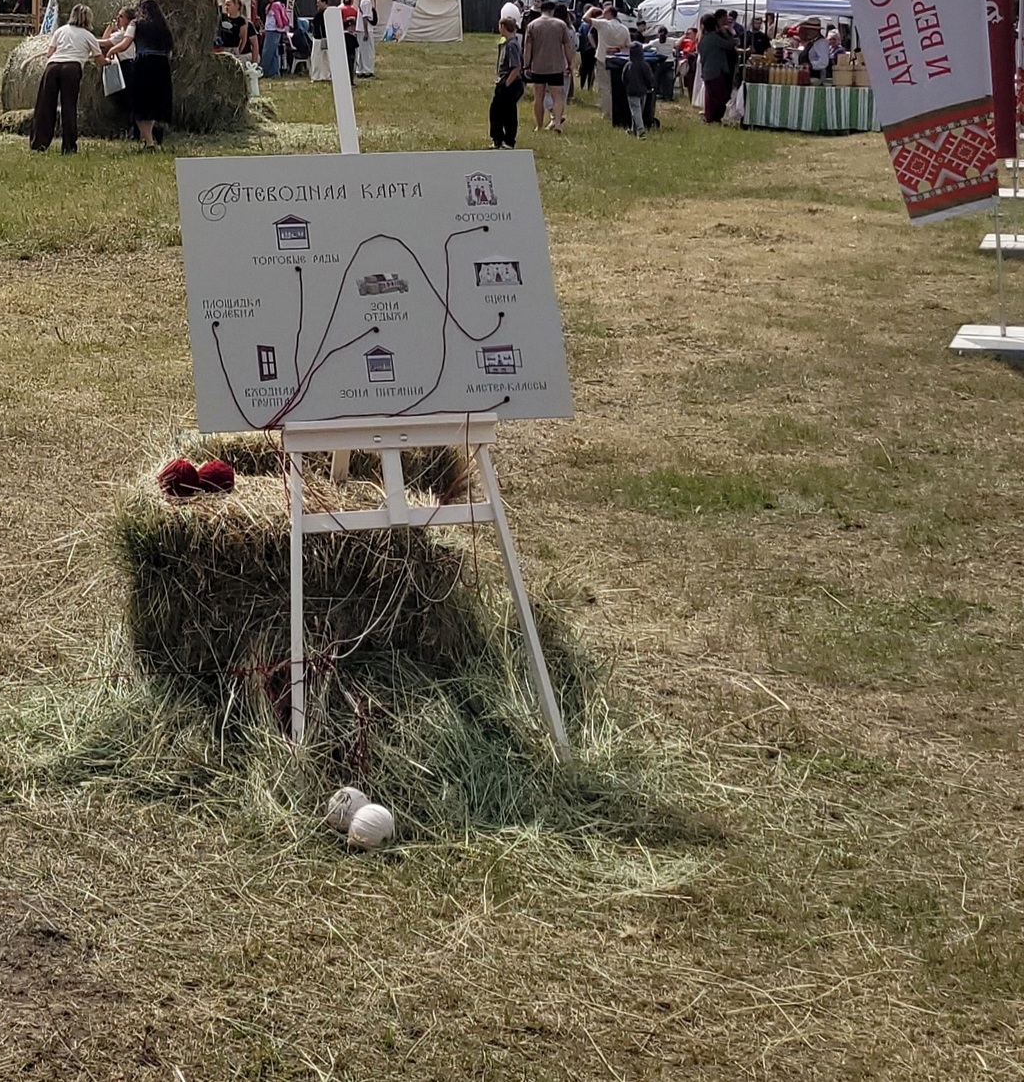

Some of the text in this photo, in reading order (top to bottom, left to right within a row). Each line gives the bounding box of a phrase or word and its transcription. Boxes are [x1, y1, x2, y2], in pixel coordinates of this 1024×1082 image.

[878, 13, 918, 86] ДЕНЬ
[925, 54, 952, 80] И
[198, 182, 422, 221] ПУТЕВОДНАЯ КАРТА
[455, 212, 512, 222] ФОТОЗОНА
[252, 254, 339, 266] ТОРГОВЫЕ РЯДЫ
[202, 298, 261, 309] ПЛОЩАДКА
[484, 294, 517, 305] СЦЕНА
[371, 302, 399, 311] ЗОНА
[204, 309, 255, 319] МОЛЕБНА
[364, 312, 408, 322] ОТДЫХА
[244, 386, 296, 398] ВХОДНАЯ
[340, 386, 423, 399] ЗОНА ПИТАНИЯ
